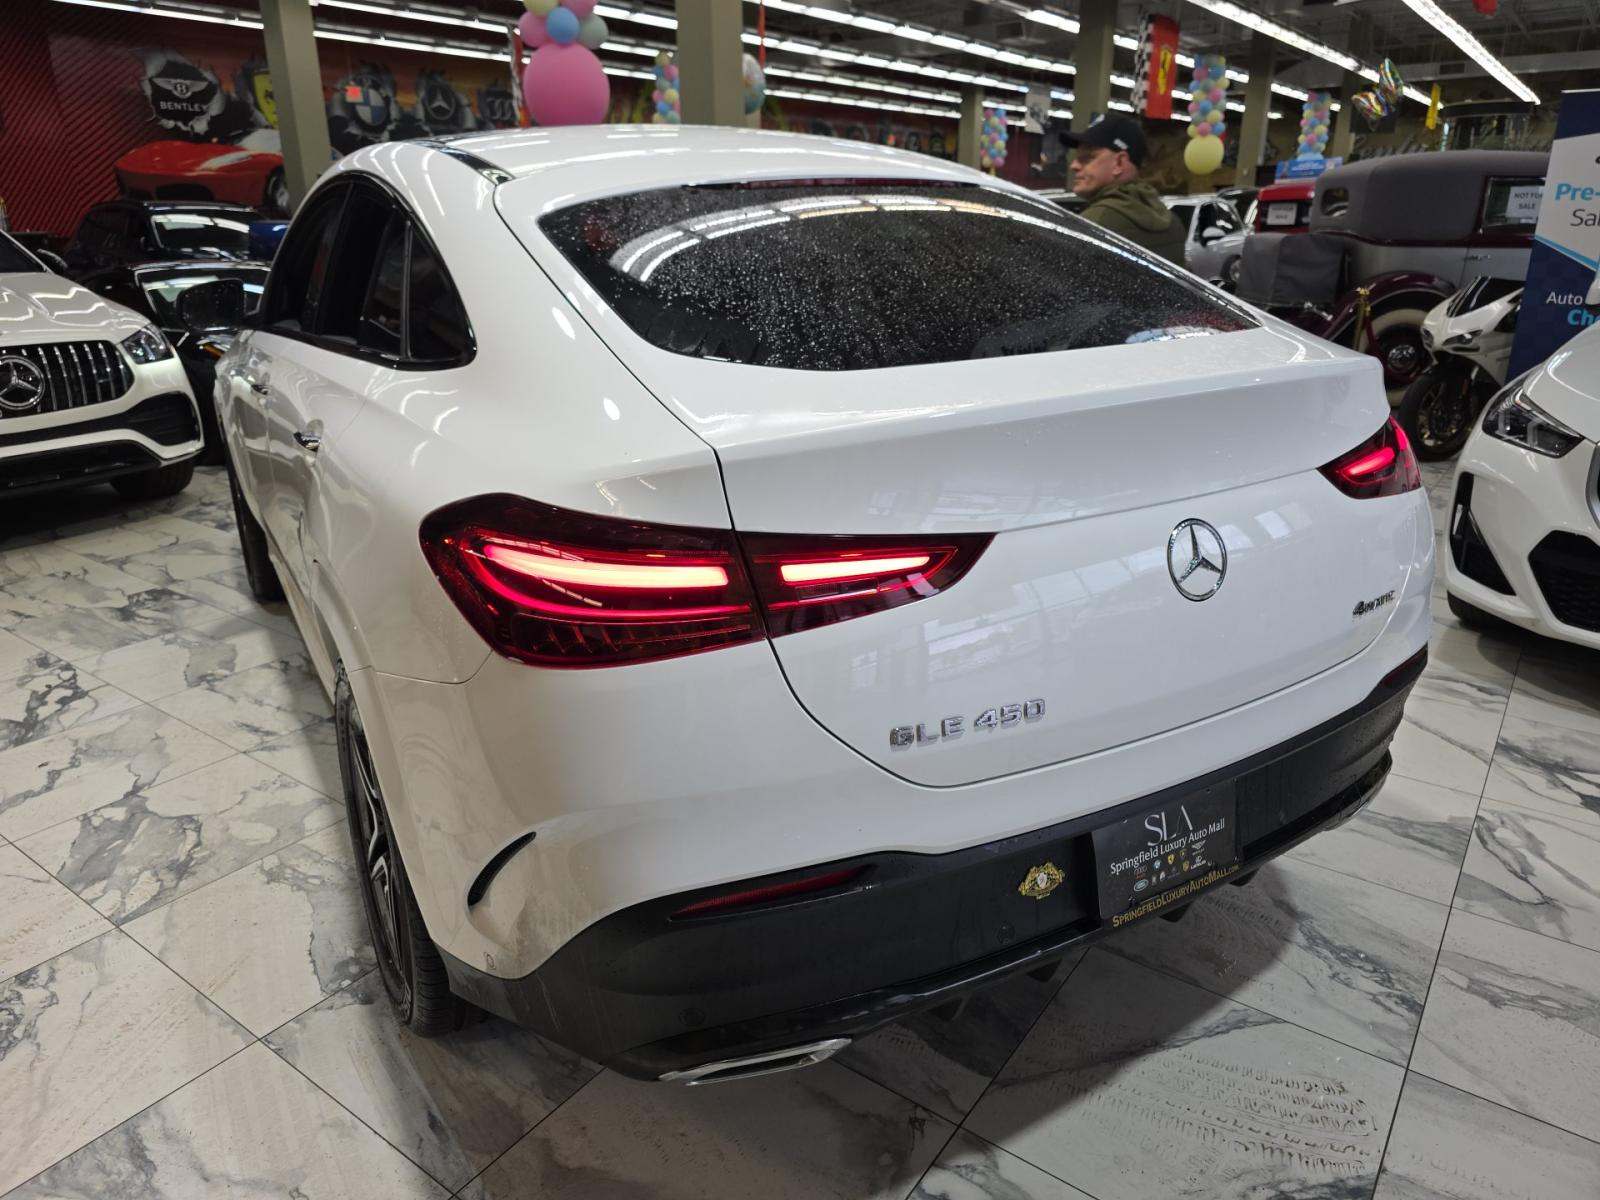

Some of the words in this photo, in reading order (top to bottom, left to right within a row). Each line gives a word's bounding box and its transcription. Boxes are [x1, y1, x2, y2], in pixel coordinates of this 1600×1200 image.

[160, 101, 208, 112] BENTLEY
[1514, 192, 1529, 200] NOT
[1555, 183, 1600, 201] Pre-
[1546, 291, 1583, 305] Auto
[890, 715, 966, 747] GLE
[974, 699, 1046, 729] 450
[1144, 804, 1193, 846] SLA
[1110, 847, 1159, 875] Springfield
[1160, 836, 1188, 855] Luxury
[1188, 829, 1207, 844] Auto
[1208, 817, 1225, 836] Mall
